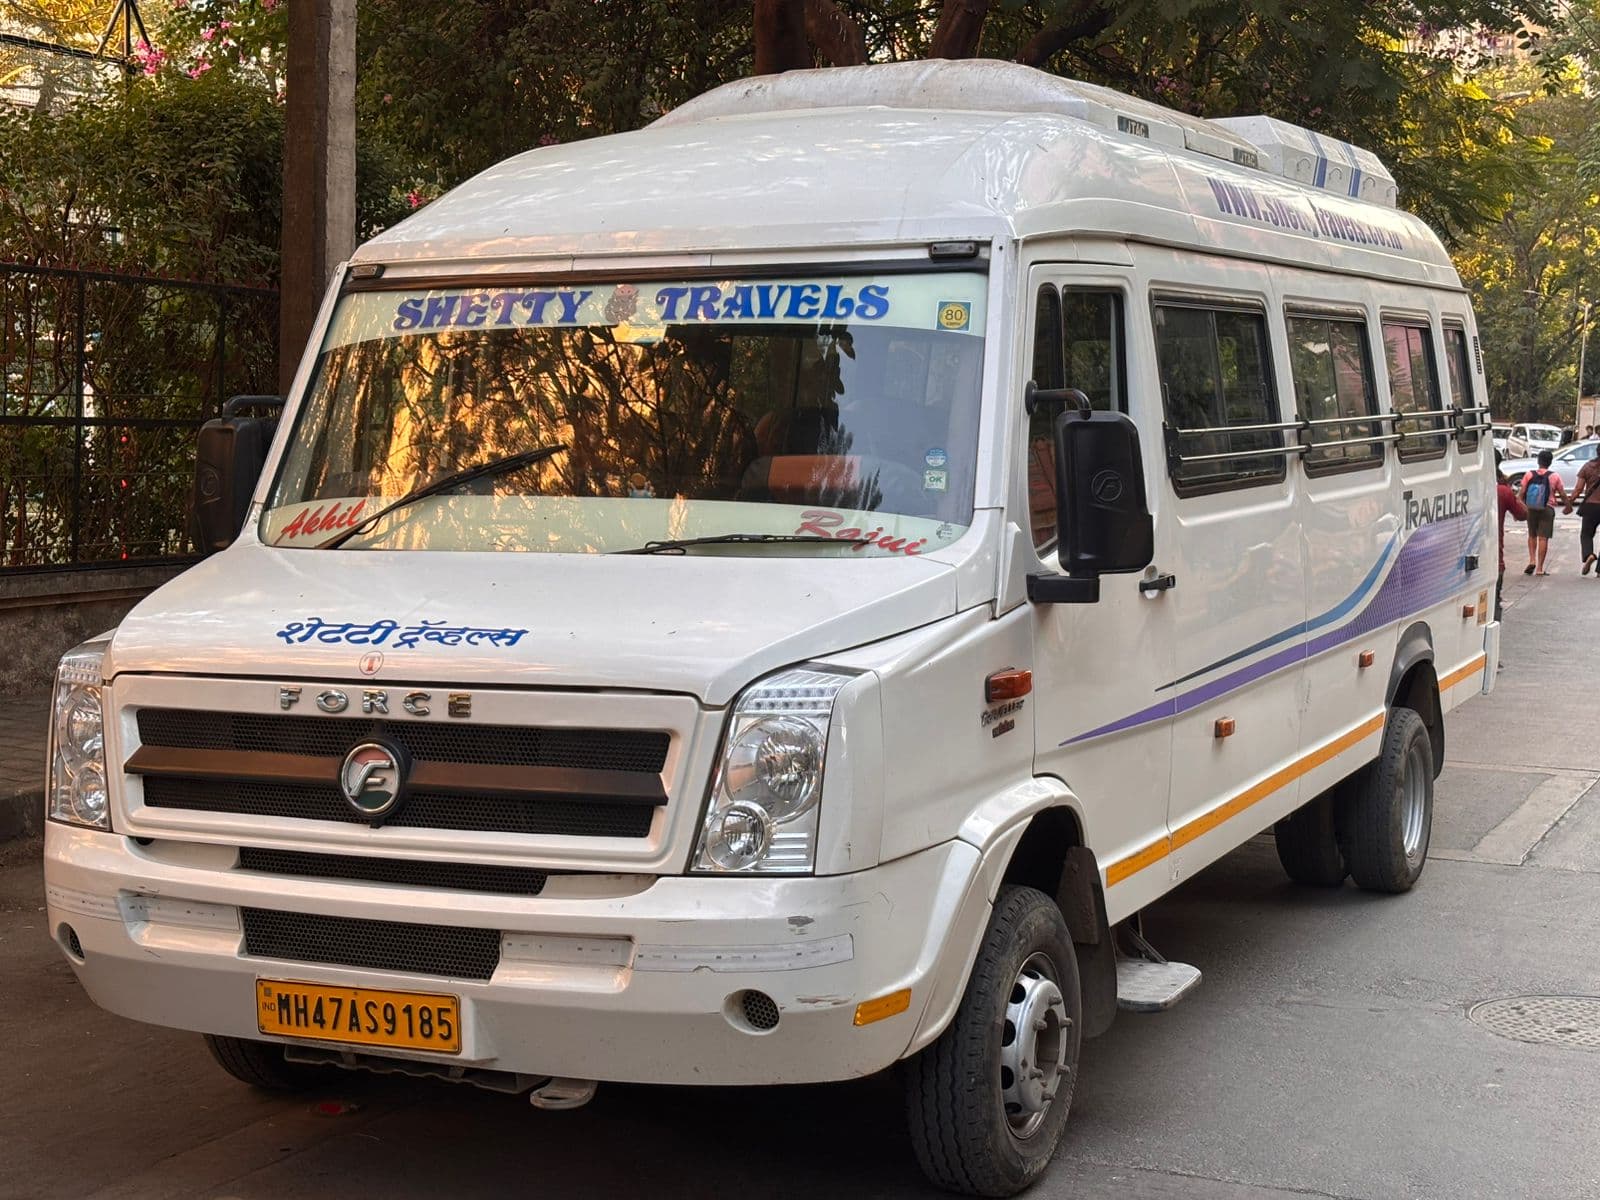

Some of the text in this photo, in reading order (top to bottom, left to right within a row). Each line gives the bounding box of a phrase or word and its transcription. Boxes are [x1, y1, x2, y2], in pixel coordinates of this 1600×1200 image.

[393, 284, 890, 330] SHETTY TRAVELS
[945, 309, 963, 321] 80
[273, 499, 367, 546] Akhil
[279, 686, 472, 718] FORCE
[262, 993, 451, 1040] IND MH47AS9185
